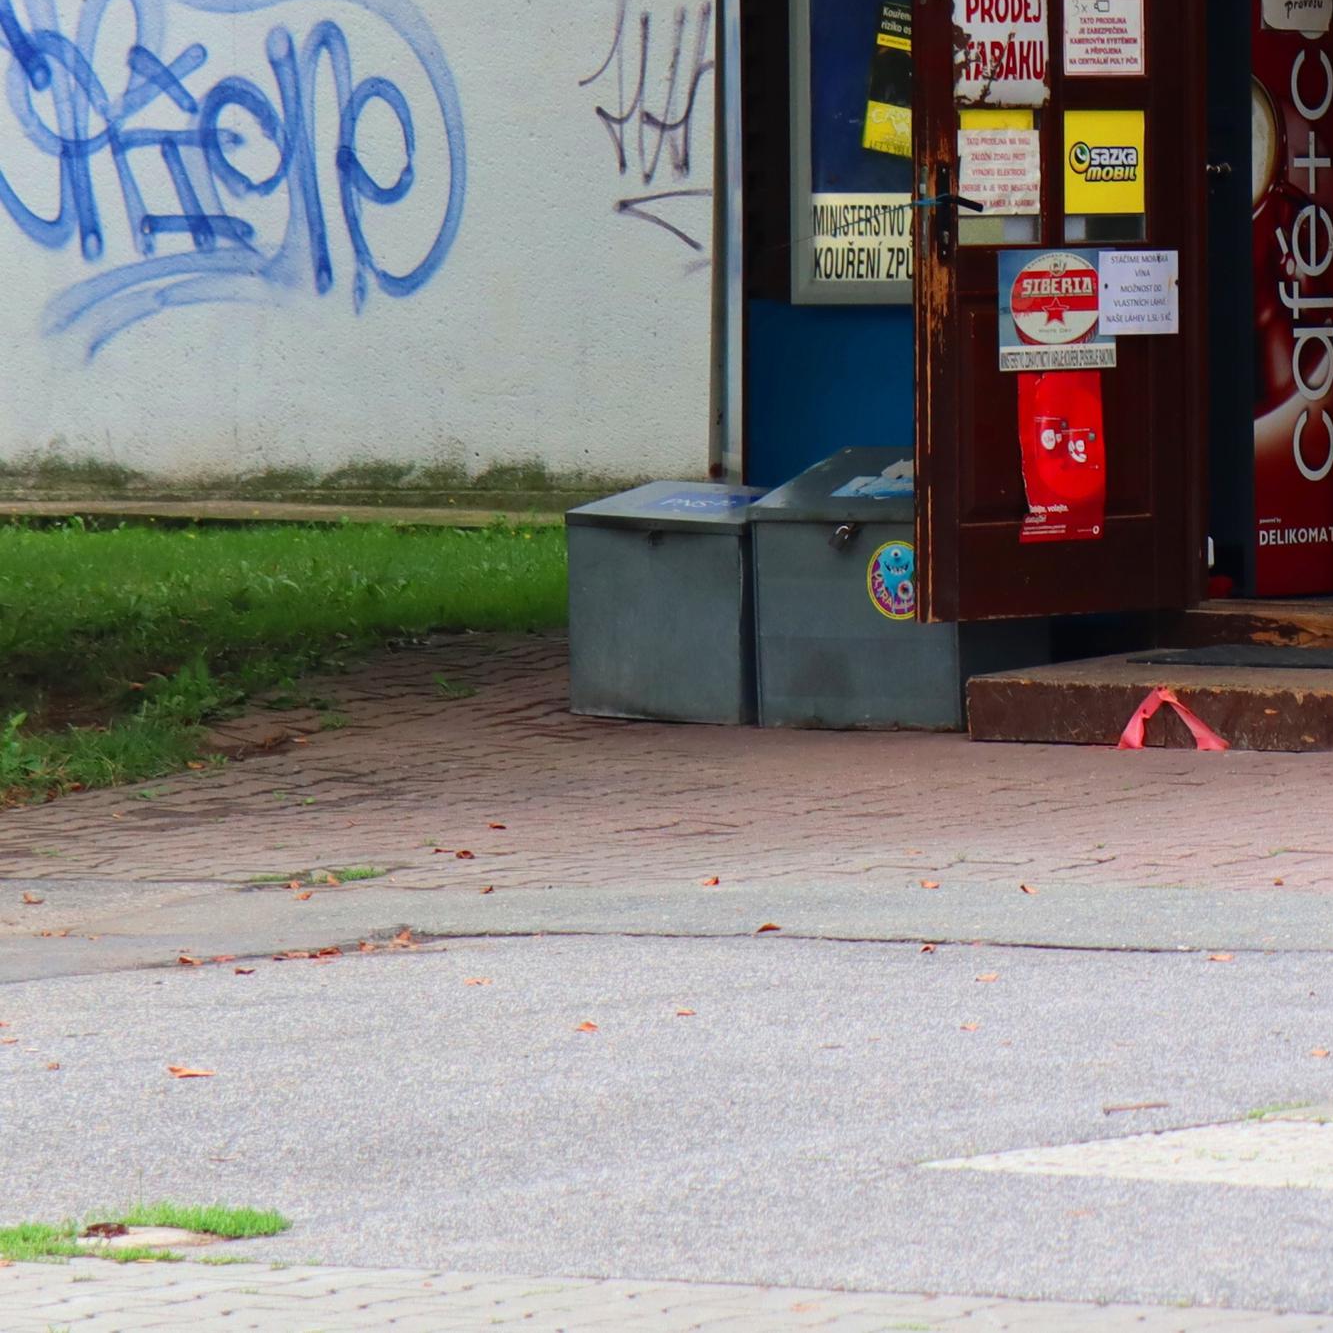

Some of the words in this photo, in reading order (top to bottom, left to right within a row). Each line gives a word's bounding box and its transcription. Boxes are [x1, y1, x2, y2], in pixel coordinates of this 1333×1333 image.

[964, 33, 1044, 81] TABÁKU
[1089, 147, 1139, 166] sazka
[1085, 167, 1138, 181] MOBIL
[813, 204, 904, 238] MINISTERSTVO
[814, 241, 882, 280] KOUŘENÍ
[1022, 277, 1093, 296] SIBERIA
